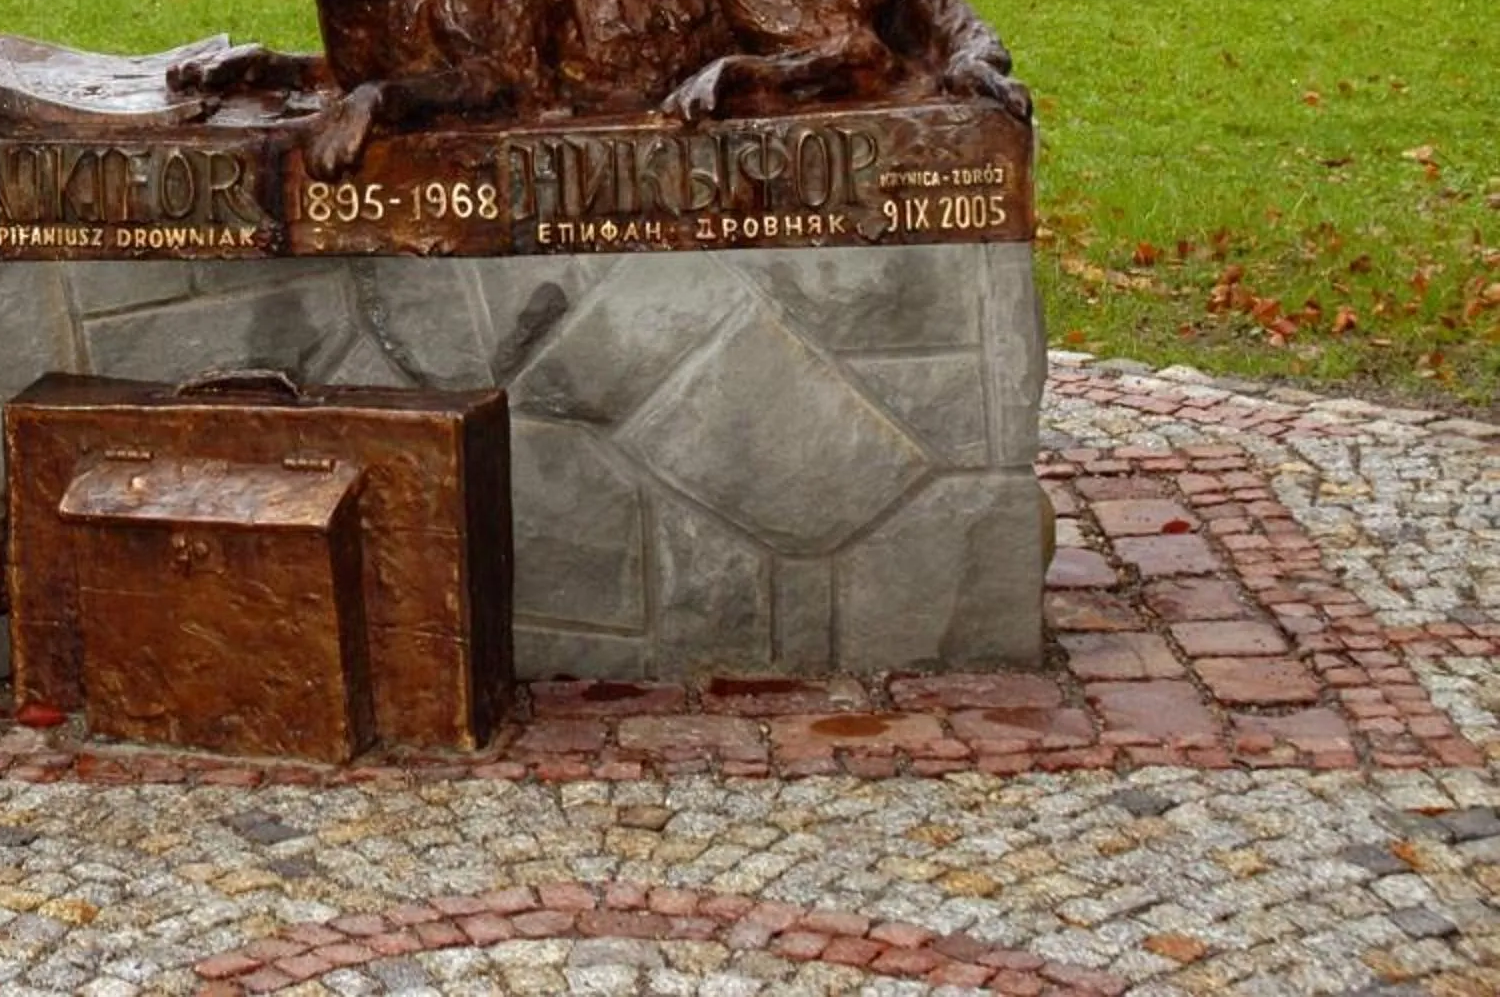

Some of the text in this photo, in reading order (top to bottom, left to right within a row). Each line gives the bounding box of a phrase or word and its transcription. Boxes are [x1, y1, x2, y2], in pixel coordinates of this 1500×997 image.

[883, 195, 1006, 232] 9 IX 2005
[116, 225, 257, 248] DROWNIAK
